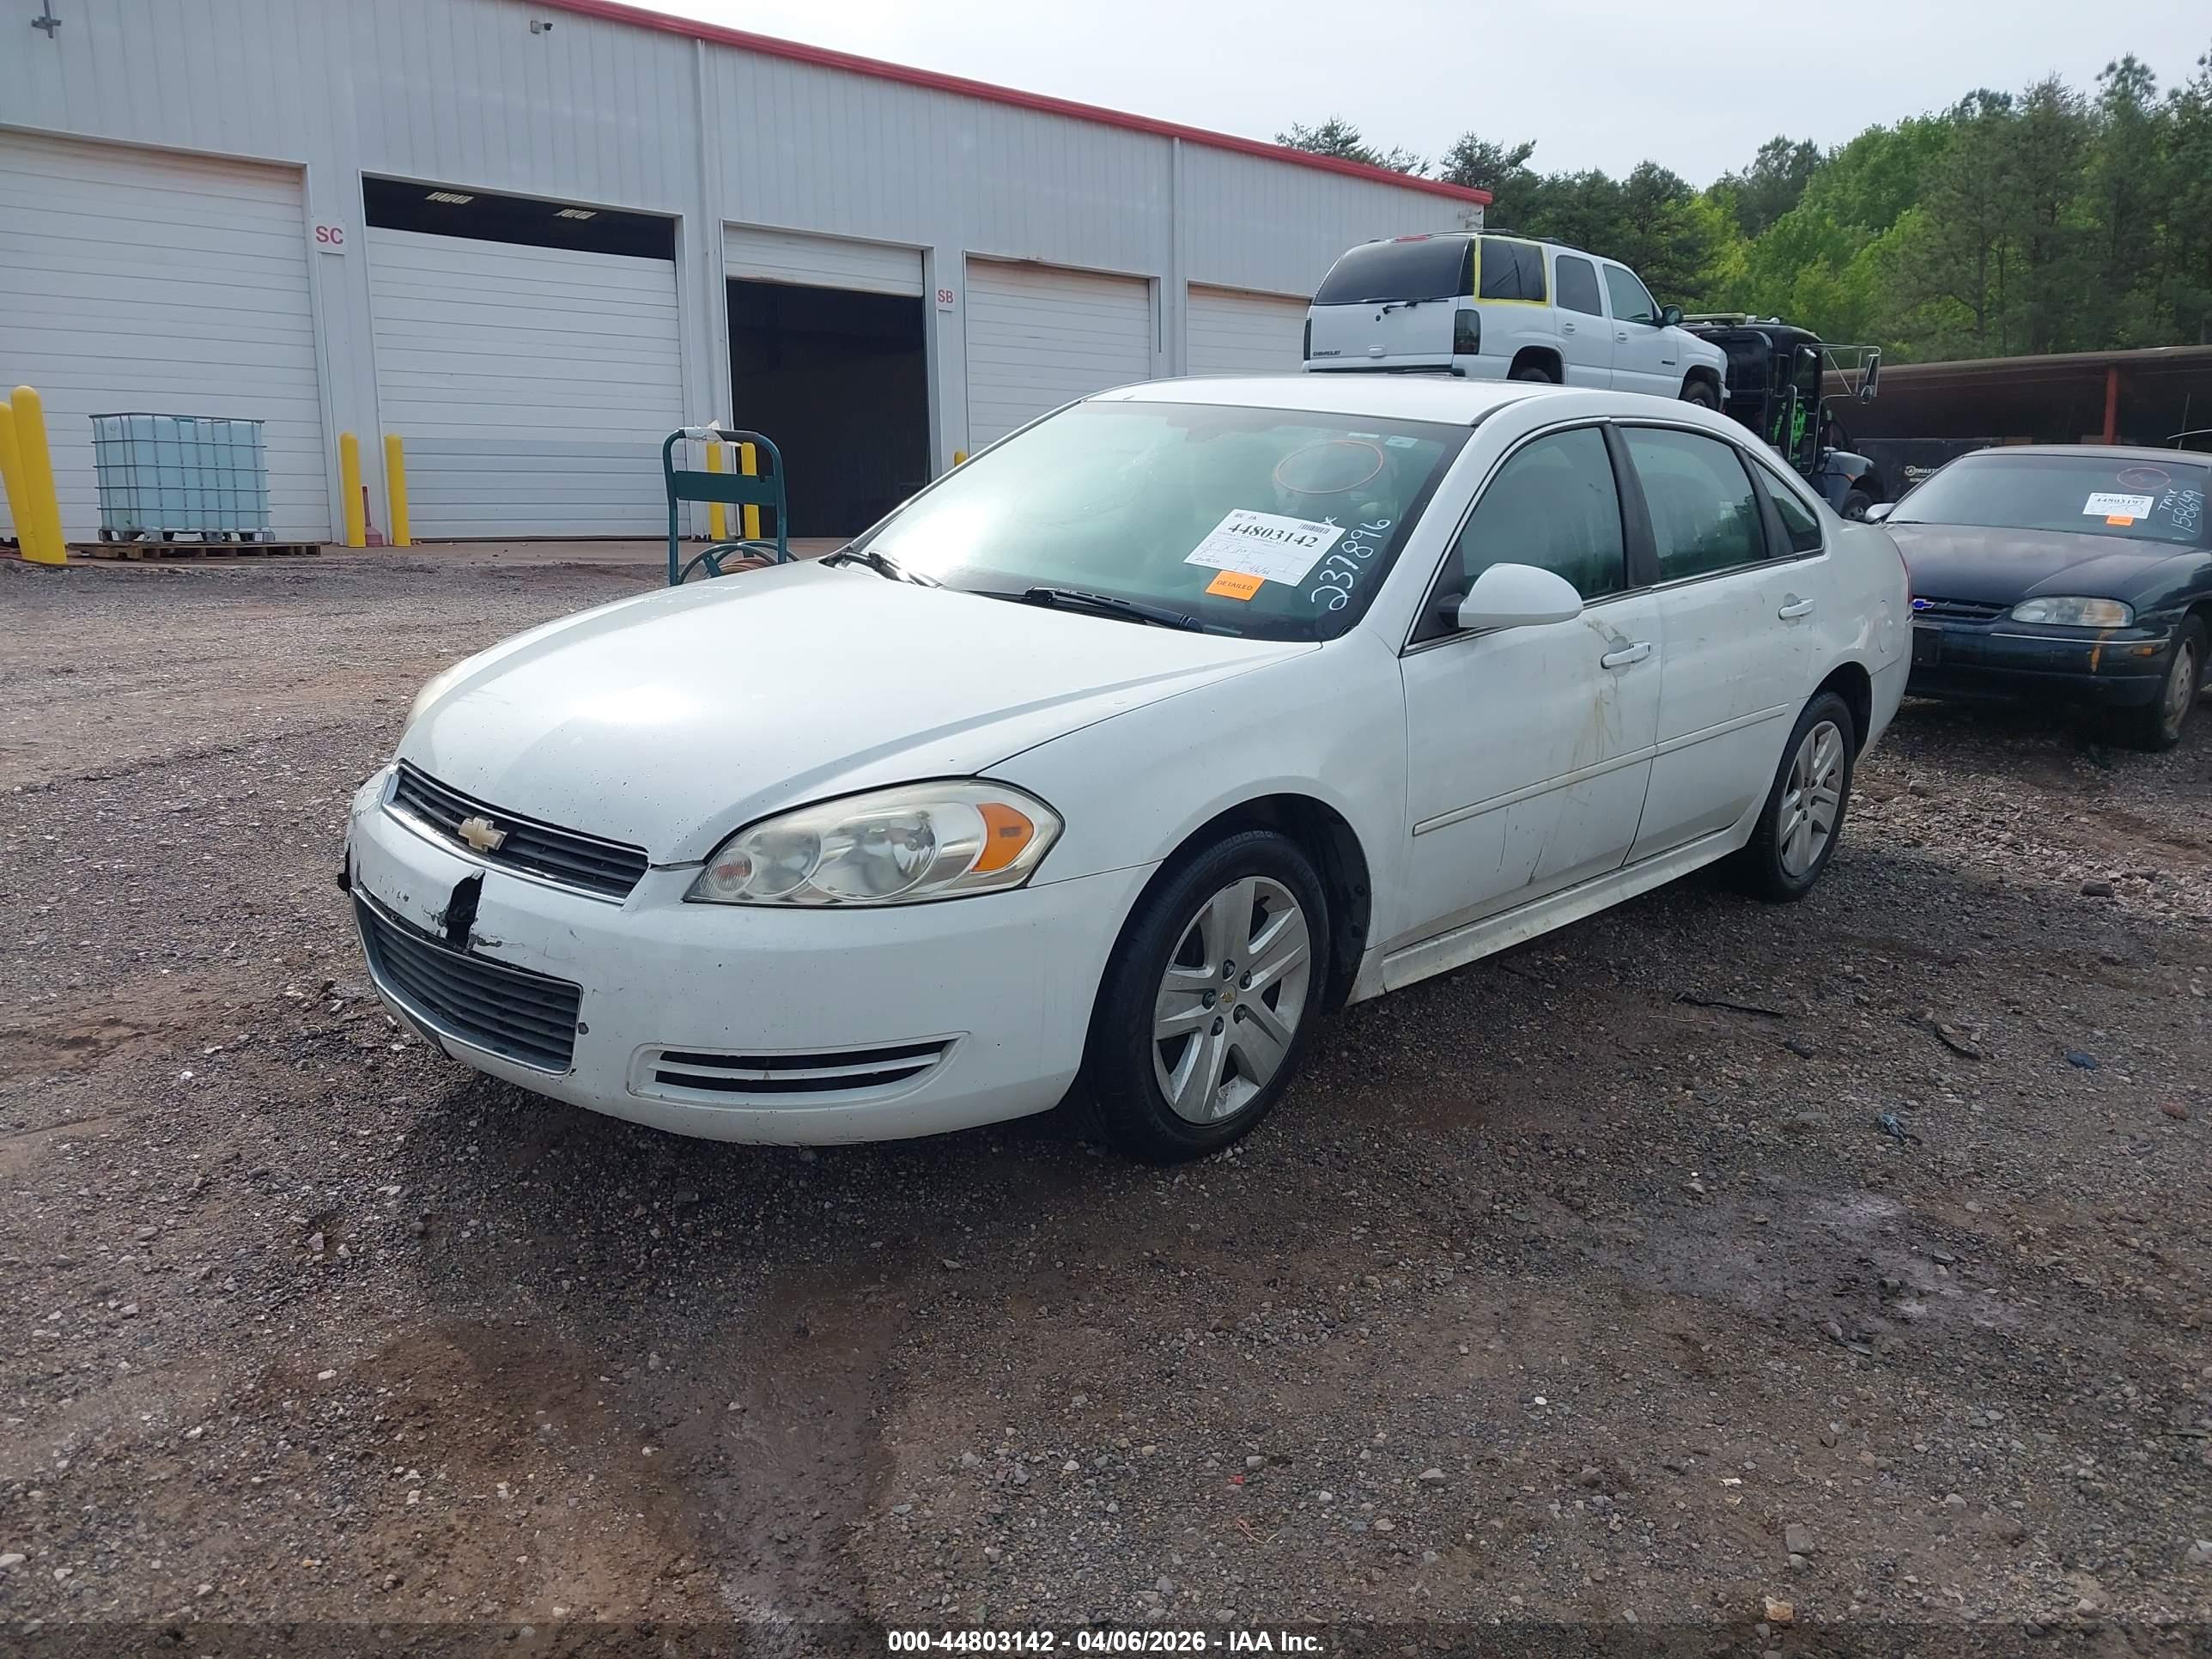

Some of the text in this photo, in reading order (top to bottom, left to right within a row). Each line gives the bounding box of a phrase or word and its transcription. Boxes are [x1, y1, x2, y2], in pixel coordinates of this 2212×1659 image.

[315, 225, 344, 245] SC
[937, 289, 954, 304] SB
[1227, 522, 1320, 548] 44803142
[1310, 519, 1391, 611] 237896
[1216, 580, 1254, 591] DETAILED
